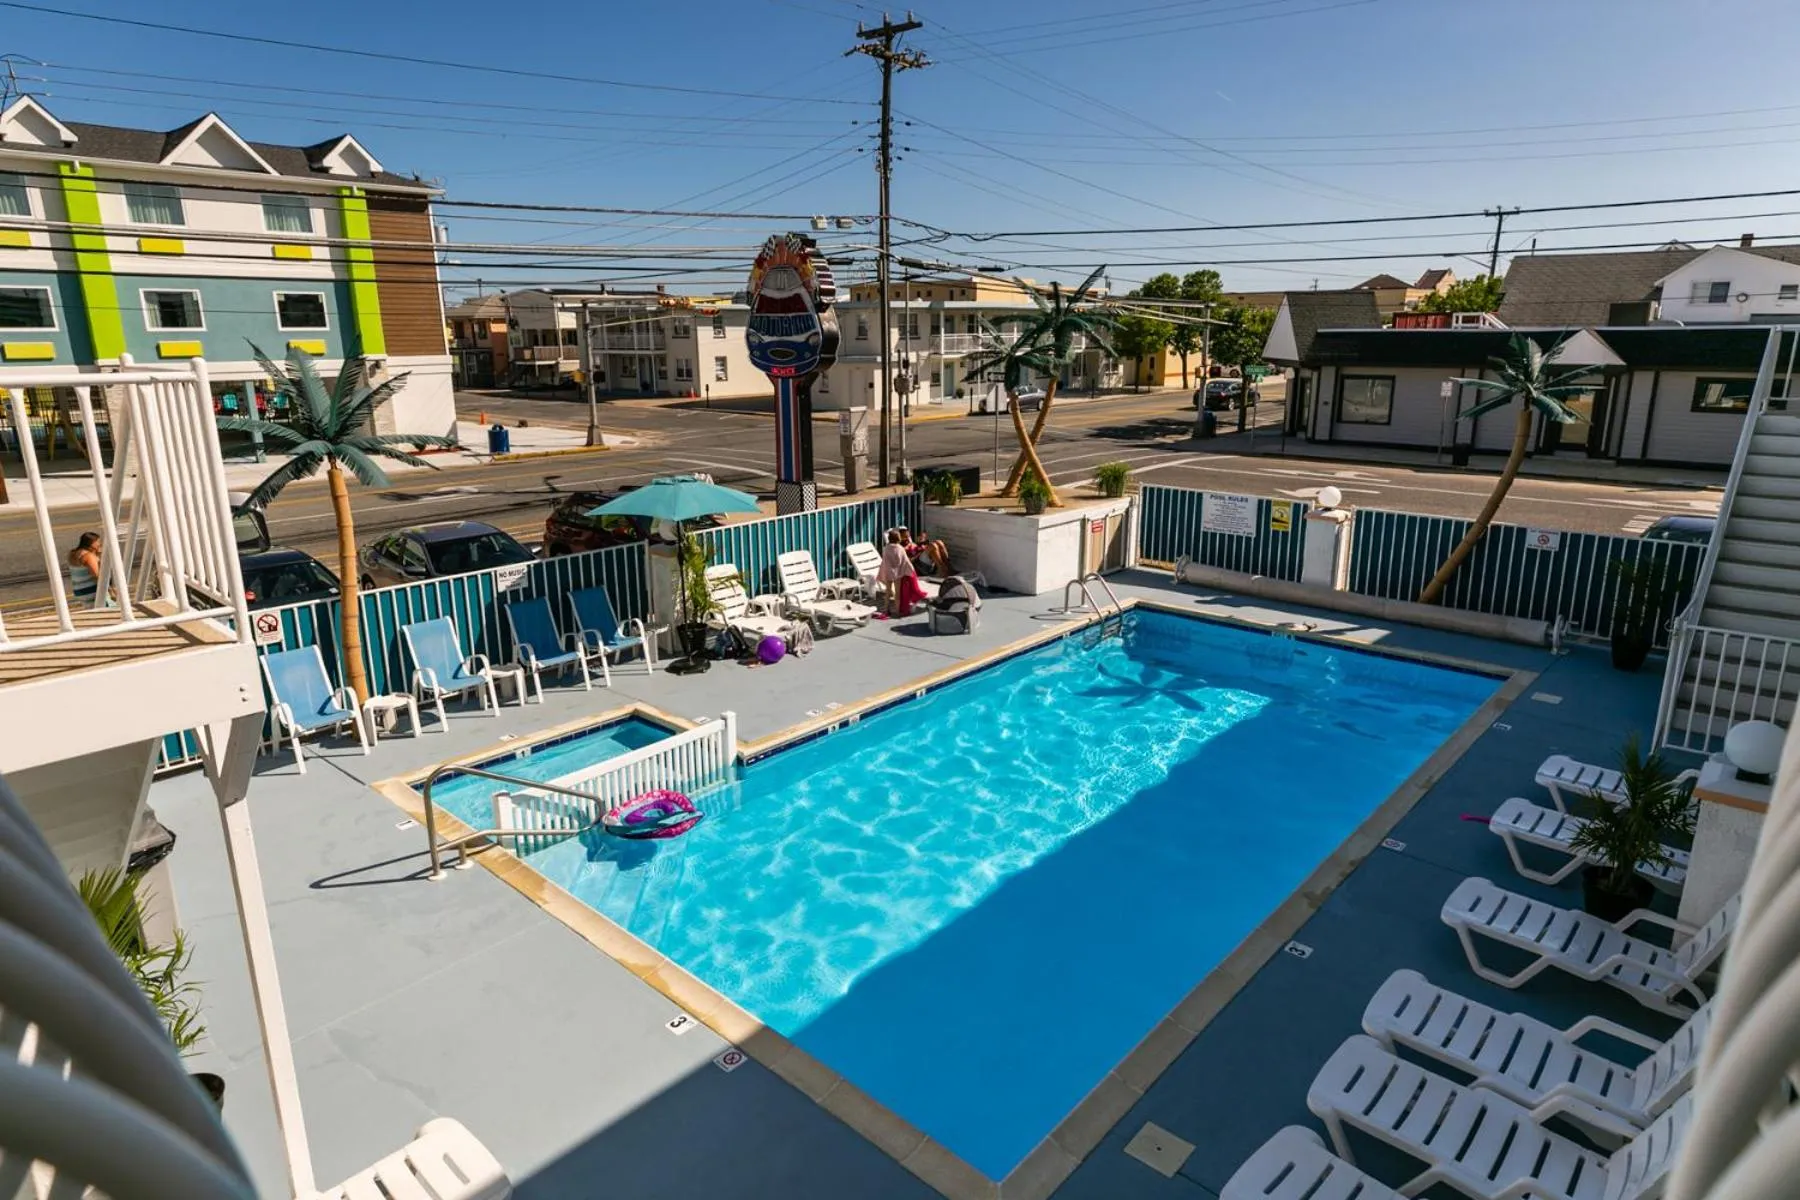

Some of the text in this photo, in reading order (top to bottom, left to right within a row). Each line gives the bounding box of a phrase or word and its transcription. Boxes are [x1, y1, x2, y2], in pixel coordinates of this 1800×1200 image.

[1210, 494, 1225, 502] POOL
[1289, 946, 1306, 957] 3
[670, 1016, 687, 1028] 3
